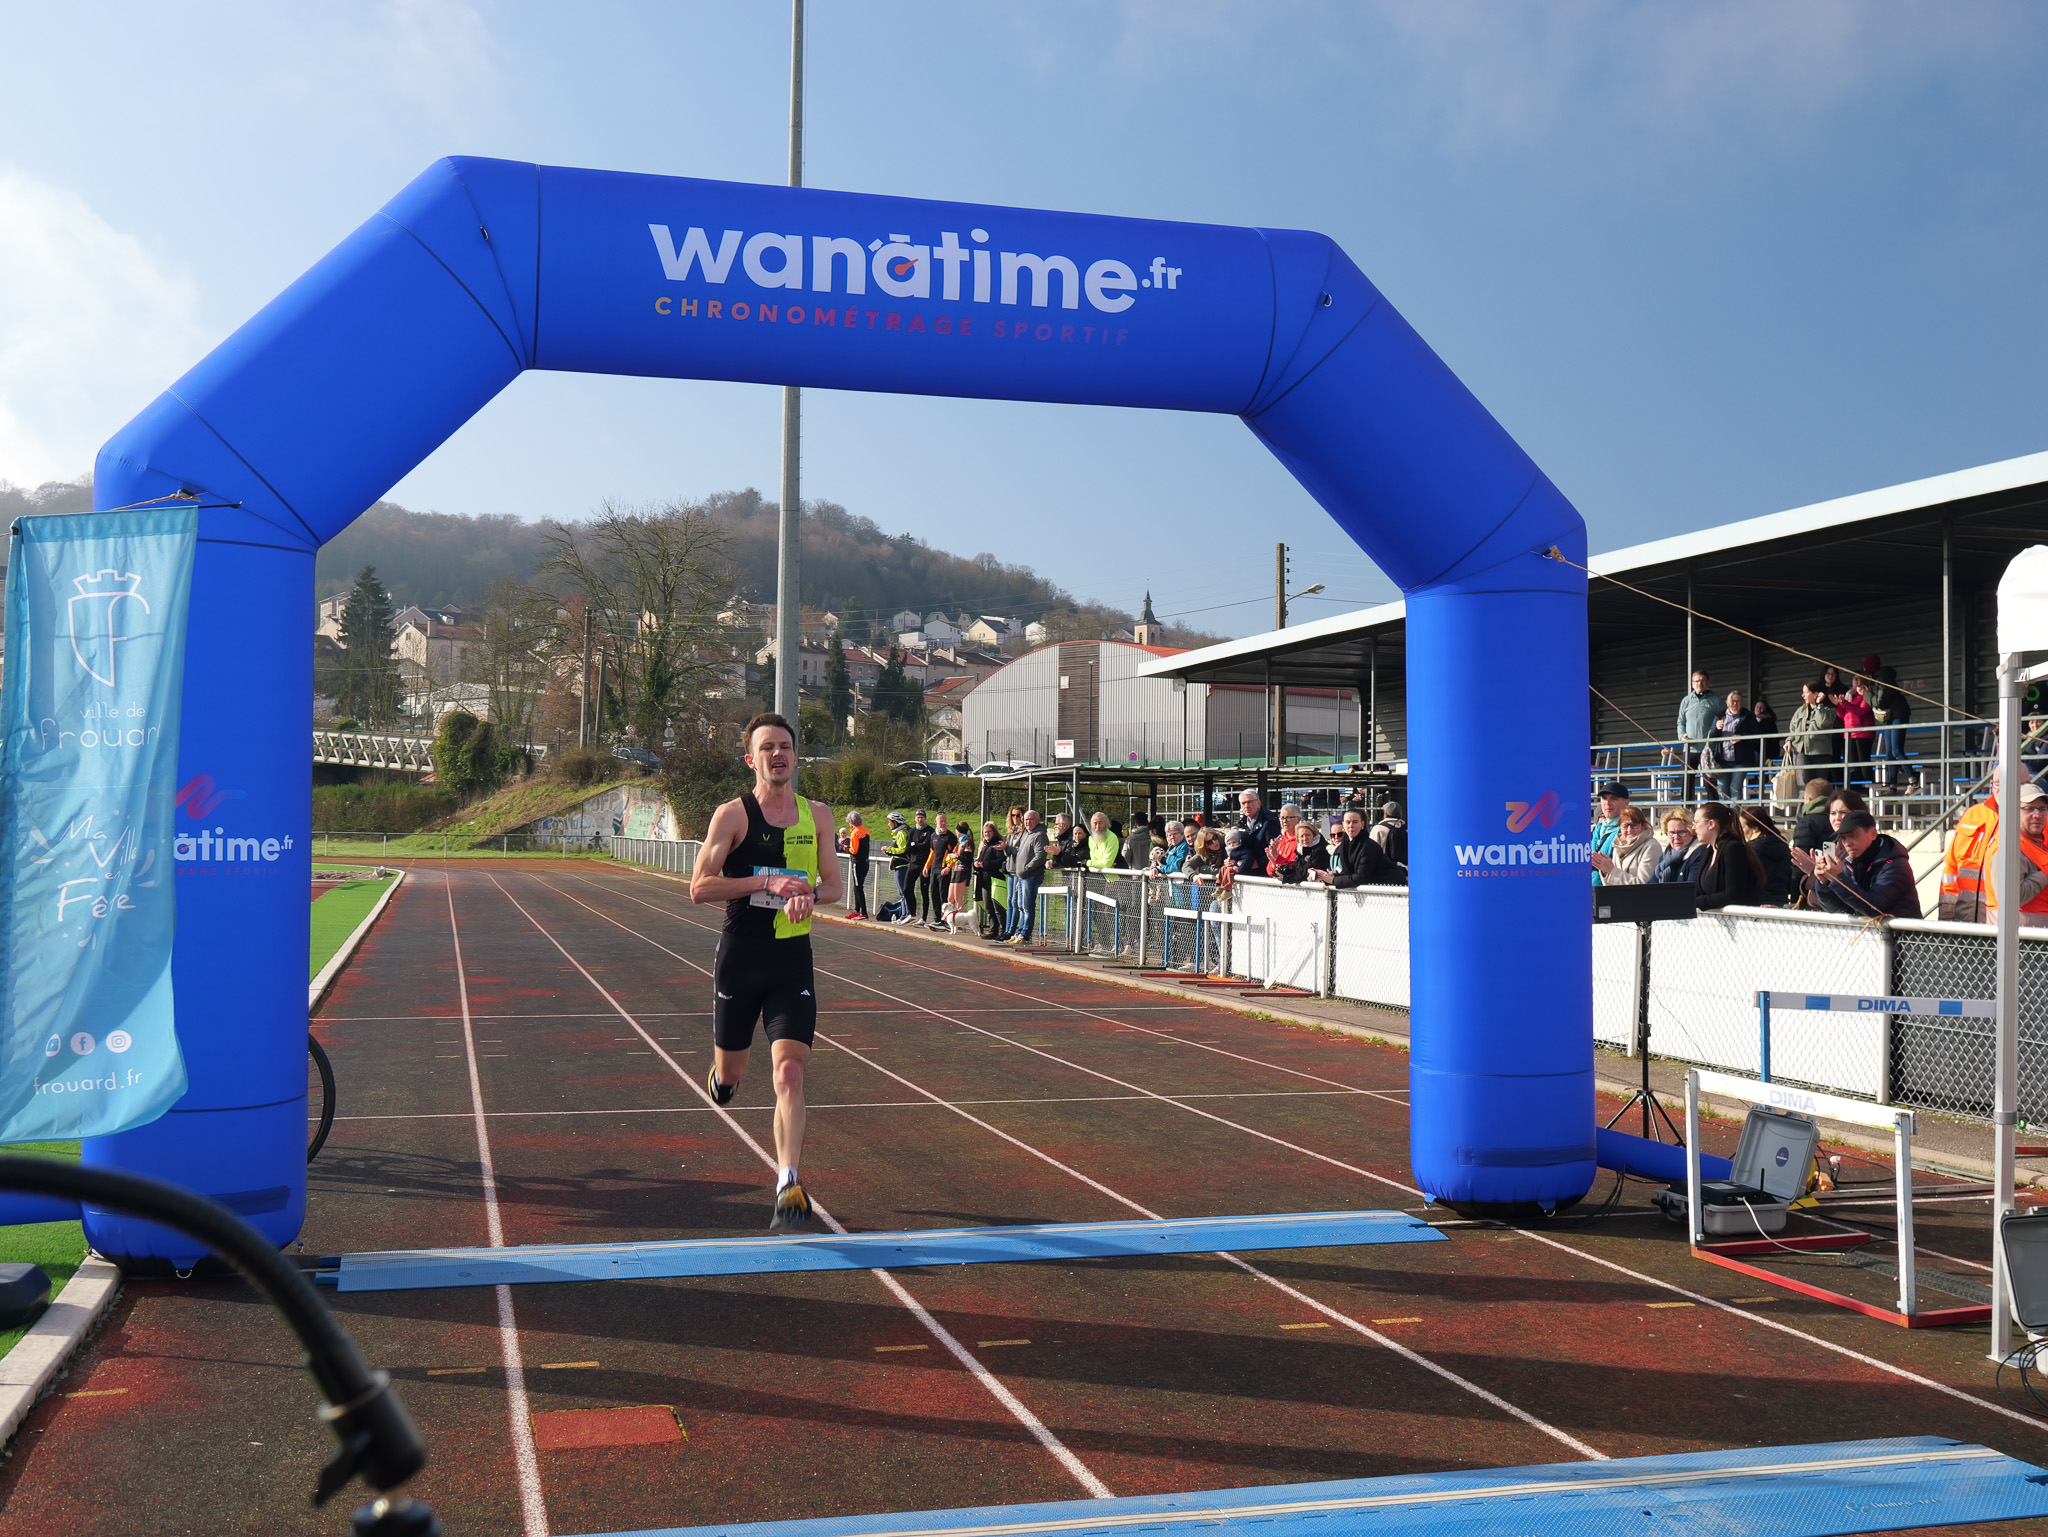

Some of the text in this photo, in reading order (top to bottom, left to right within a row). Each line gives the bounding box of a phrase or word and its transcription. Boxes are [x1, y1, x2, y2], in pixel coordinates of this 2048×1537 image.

[654, 296, 1129, 346] CHRONOMÉTRAGE SPORTIF
[80, 701, 146, 719] ville de
[59, 815, 107, 841] Ma
[173, 827, 294, 861] atime.fr
[1858, 999, 1911, 1012] DIMA
[33, 1069, 142, 1095] frouard.fr
[1770, 1090, 1816, 1112] DIMA
